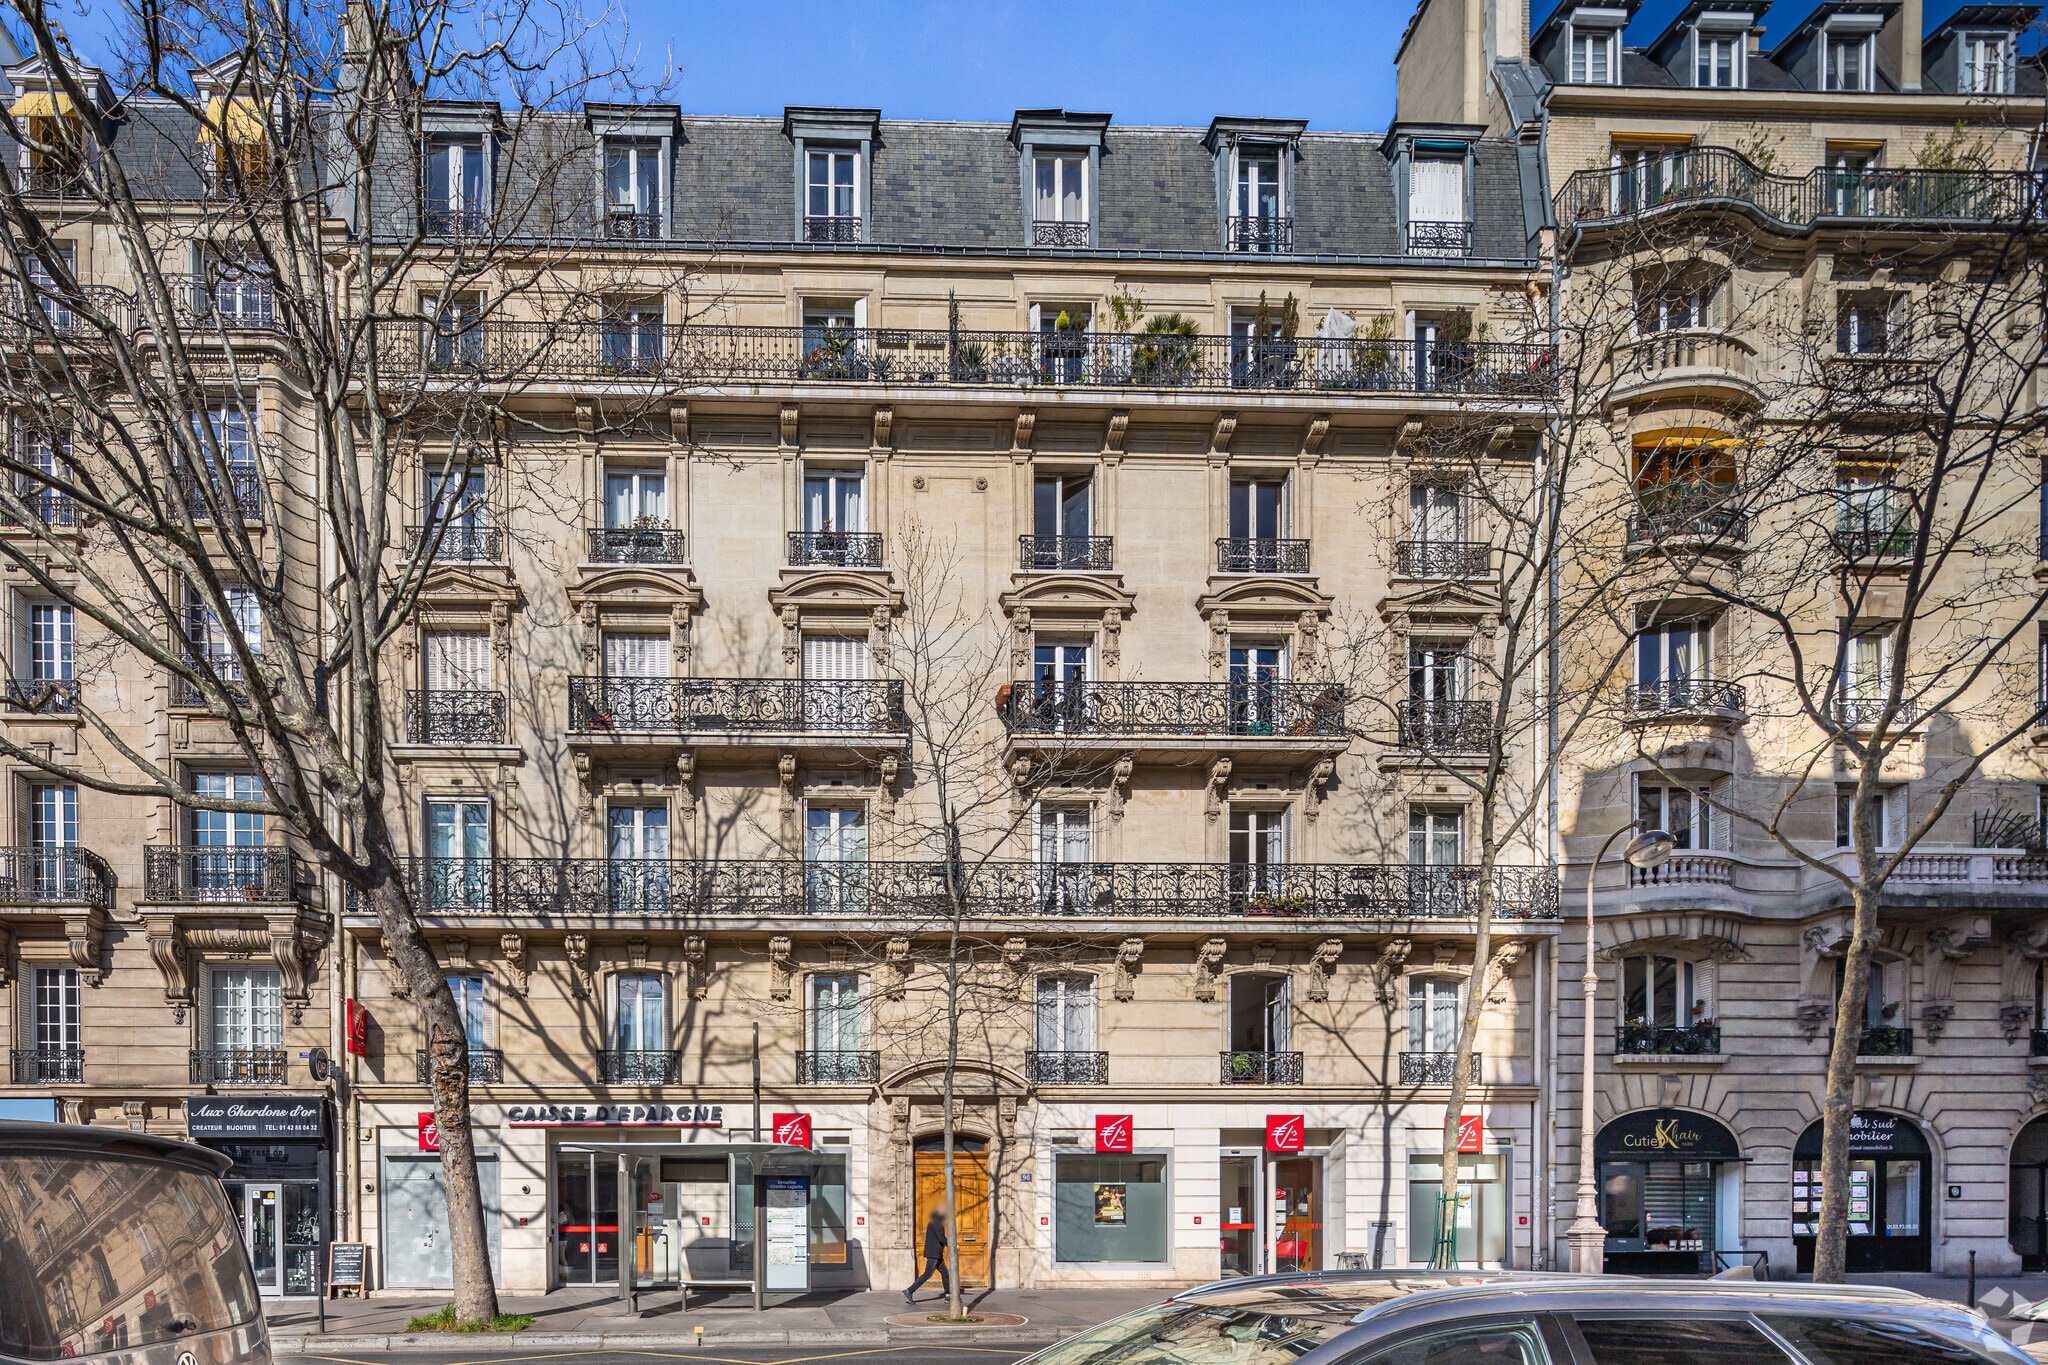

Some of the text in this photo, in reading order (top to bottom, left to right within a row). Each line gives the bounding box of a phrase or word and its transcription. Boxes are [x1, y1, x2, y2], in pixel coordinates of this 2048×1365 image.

[190, 1104, 318, 1117] Aux Chardons d'or
[508, 1106, 723, 1122] CAISSE D'EPARGNE
[1871, 1118, 1896, 1129] Sud
[1849, 1130, 1894, 1141] obilier
